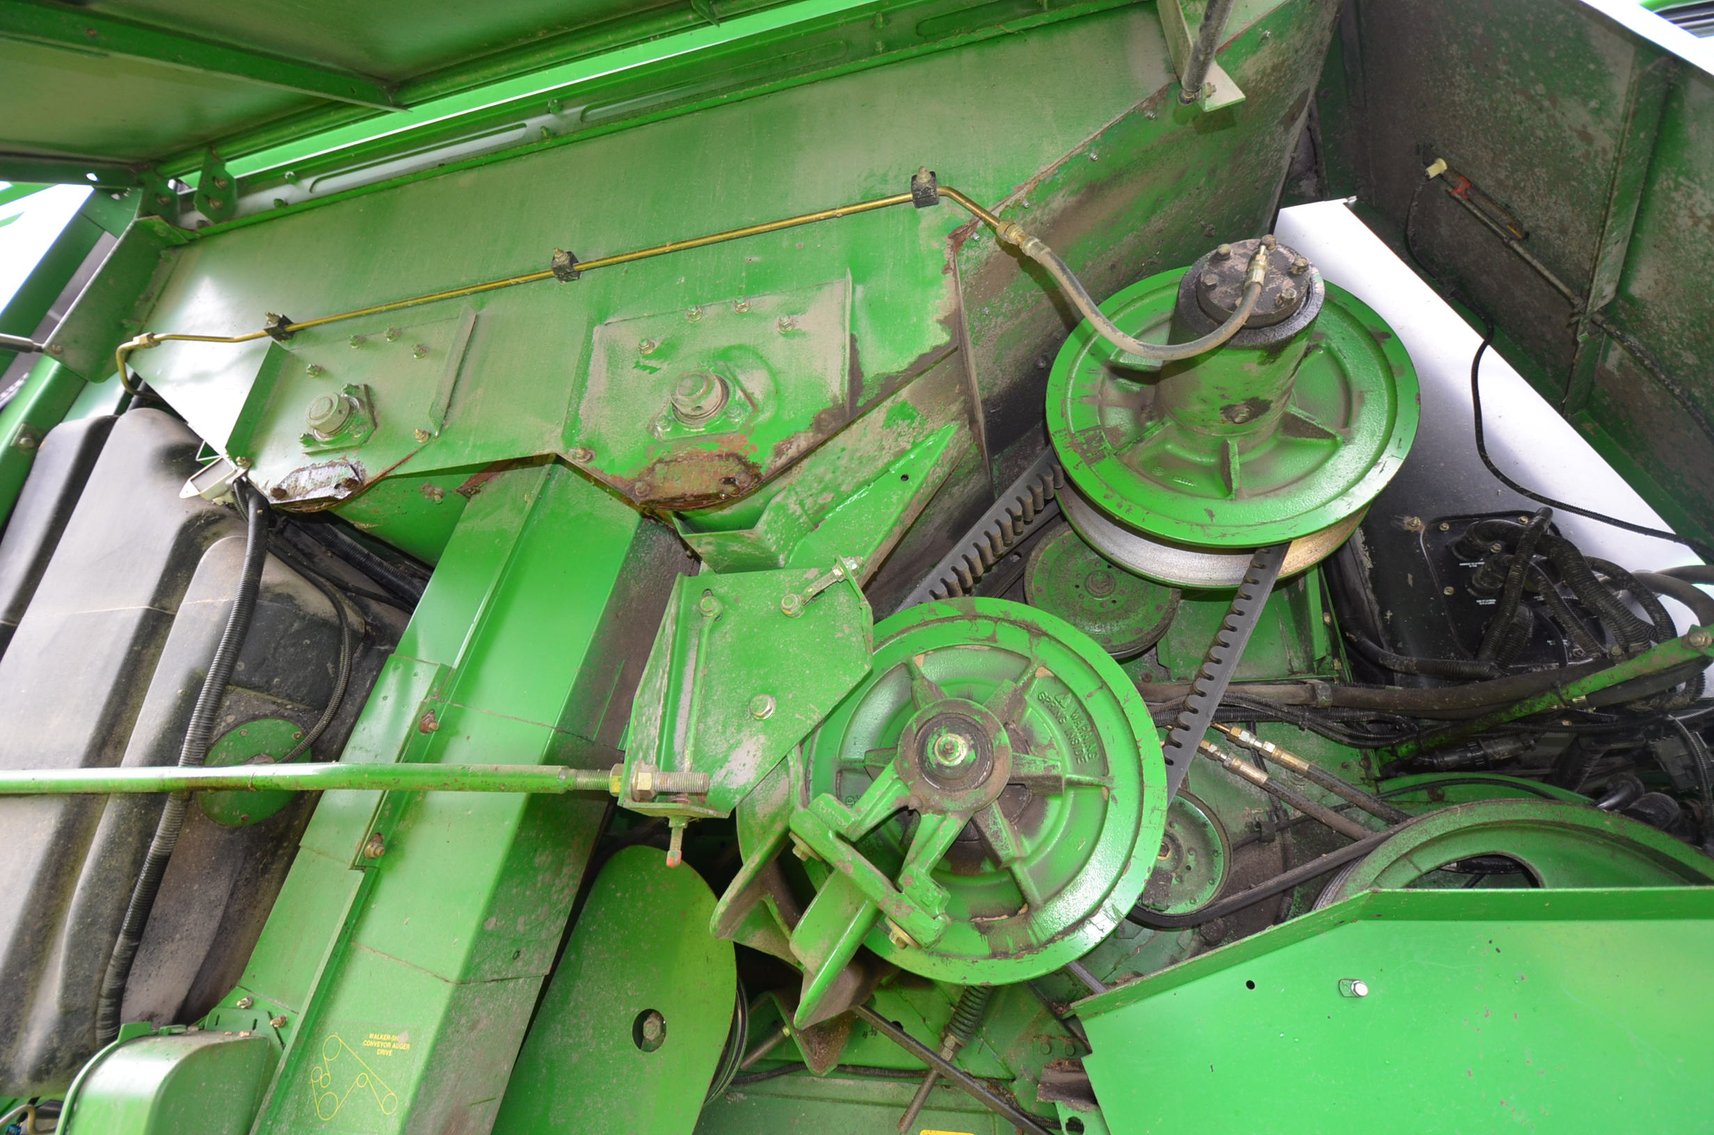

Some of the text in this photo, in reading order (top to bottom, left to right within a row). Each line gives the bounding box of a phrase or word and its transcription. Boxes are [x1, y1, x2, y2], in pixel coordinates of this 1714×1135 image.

[1038, 691, 1087, 764] SPRING INSIDE
[1071, 709, 1097, 760] WARNING
[363, 1040, 391, 1048] CONVEYOR
